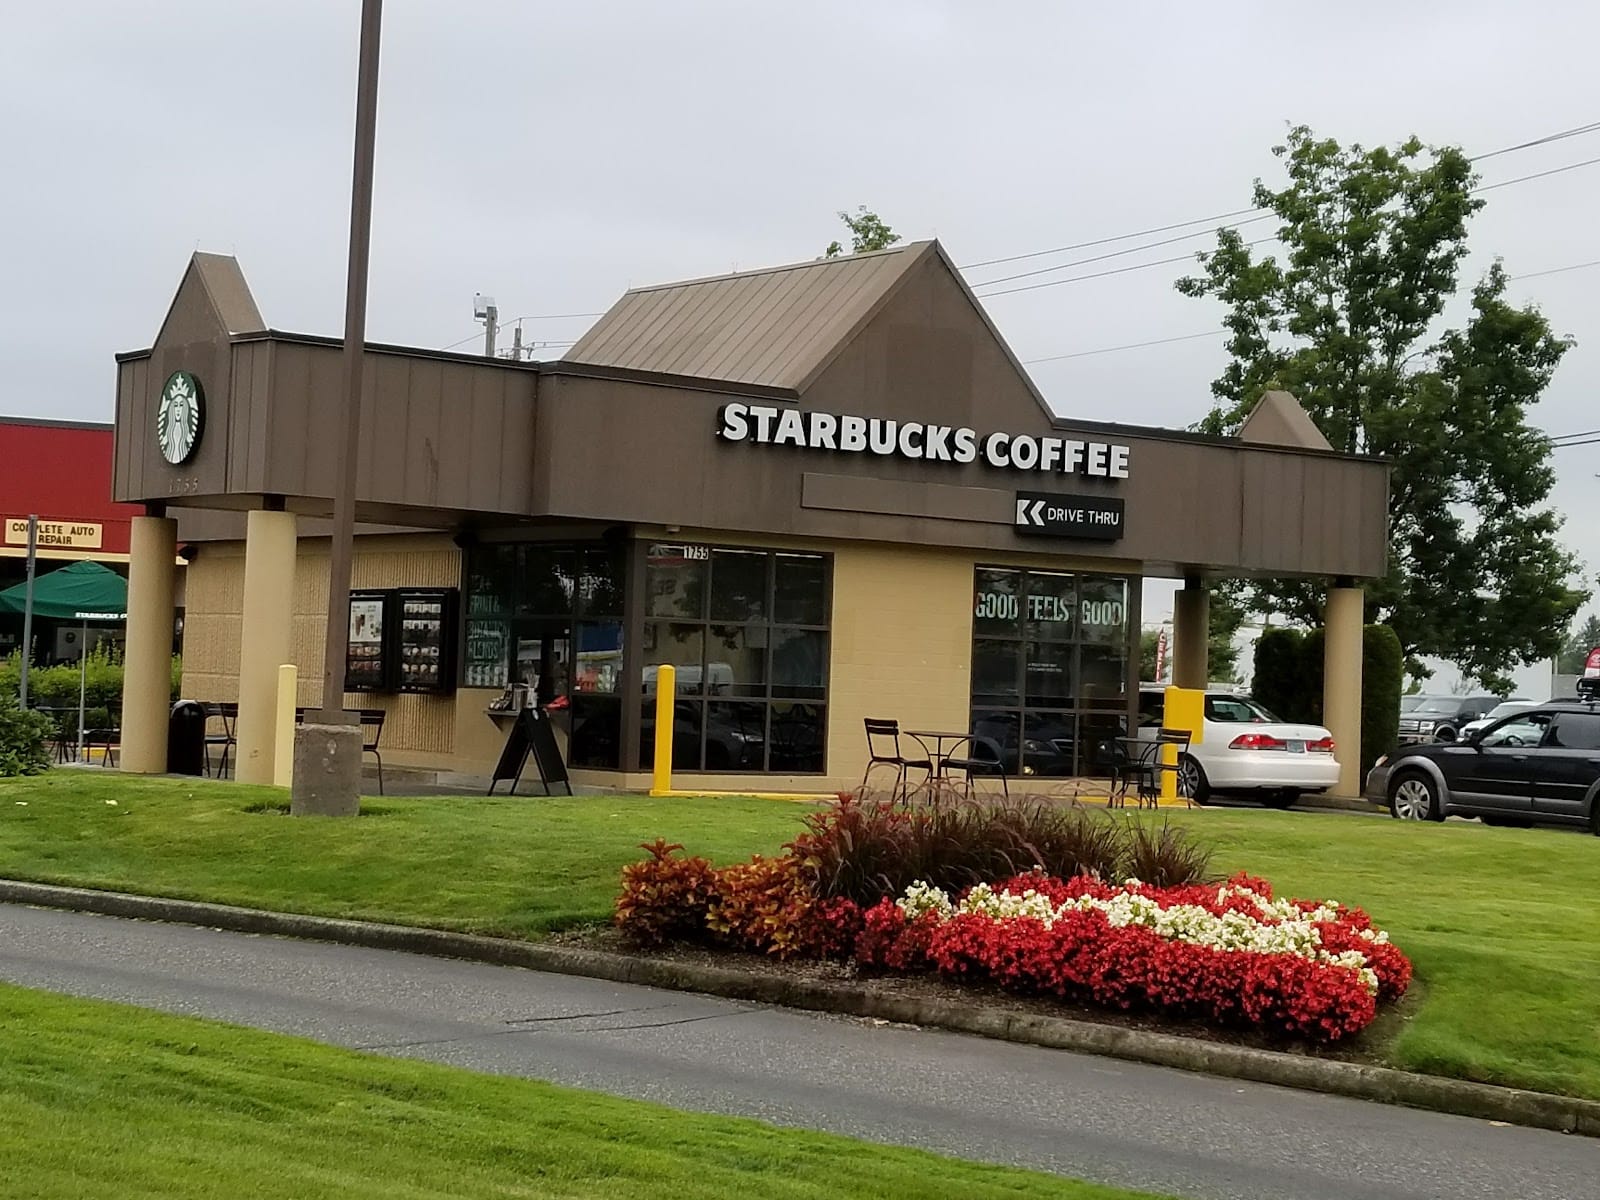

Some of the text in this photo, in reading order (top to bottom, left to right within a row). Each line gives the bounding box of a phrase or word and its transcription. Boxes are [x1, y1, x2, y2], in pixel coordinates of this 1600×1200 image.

[723, 403, 1130, 478] STARBUCKS COFFEE
[1048, 508, 1120, 526] DRIVE THRU
[12, 522, 94, 536] COPLETE AUTO
[38, 534, 72, 545] REPAIR
[684, 546, 708, 560] 1755
[976, 592, 1123, 626] GOOD FEELS GOOD
